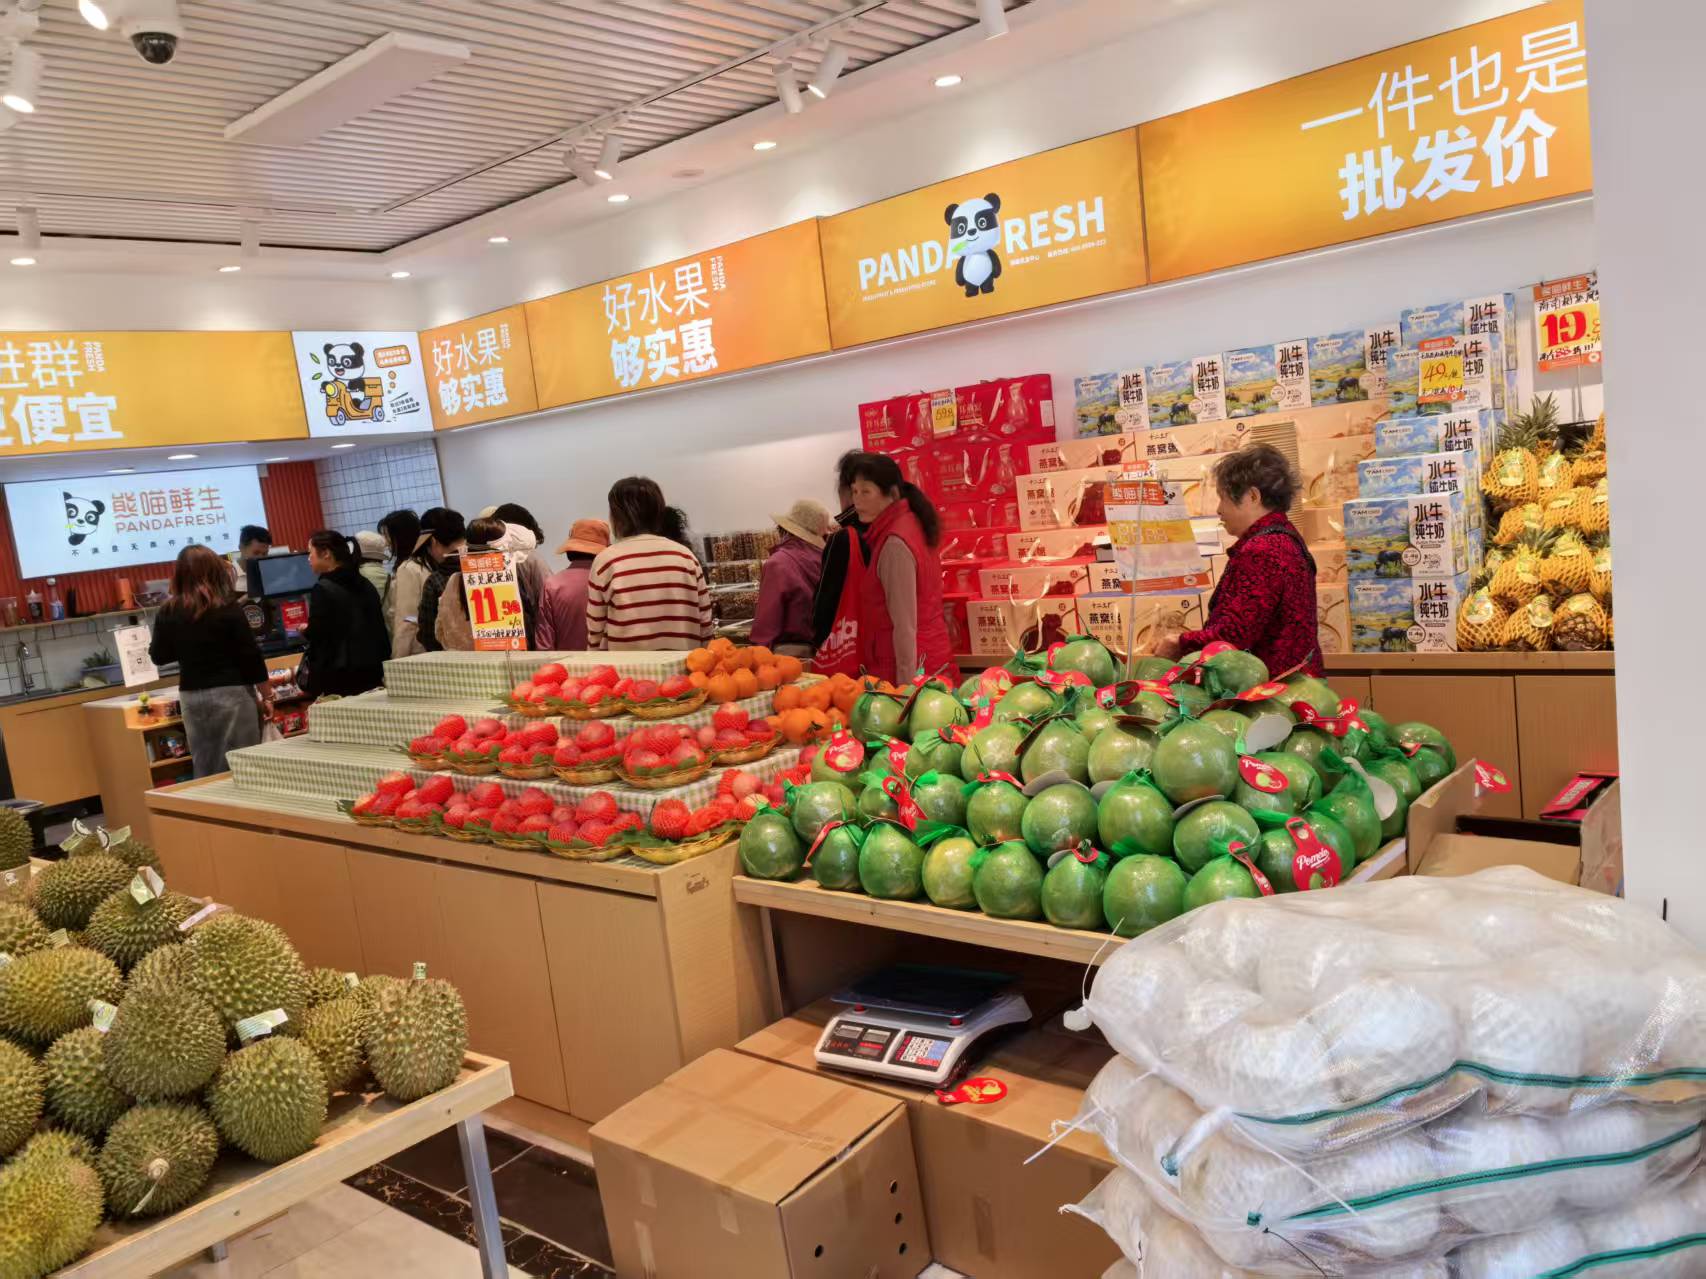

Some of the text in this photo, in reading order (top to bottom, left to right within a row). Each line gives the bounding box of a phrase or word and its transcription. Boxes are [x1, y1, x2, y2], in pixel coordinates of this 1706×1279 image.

[1301, 20, 1587, 138] 一件也是
[1338, 108, 1557, 220] 批发价
[1004, 196, 1105, 253] RESH
[603, 262, 710, 334] 好水果
[1470, 301, 1497, 322] 水牛
[1369, 330, 1395, 348] 水牛
[432, 328, 502, 377] 好水果
[610, 318, 718, 388] 够实惠
[1280, 345, 1303, 362] 水牛
[1370, 349, 1387, 366] 纯牛
[1196, 360, 1218, 377] 水牛
[1280, 361, 1304, 378] 纯牛奶
[1464, 359, 1484, 376] 牛奶
[1122, 373, 1142, 389] 水牛
[1197, 376, 1220, 392] 纯牛奶
[439, 368, 509, 417] 够实惠
[1122, 388, 1143, 403] 纯牛奶
[0, 391, 125, 446] 便宜
[1444, 419, 1472, 438] 水牛
[1428, 460, 1456, 479] 水牛
[112, 487, 224, 518] 熊喵鲜生
[1414, 502, 1443, 521] 水牛
[115, 513, 227, 534] PANDAFRESH
[1415, 523, 1445, 540] 纯牛奶
[1101, 578, 1121, 590] 燕窝
[1418, 582, 1448, 601] 水牛
[1419, 601, 1449, 619] 纯牛奶
[1296, 847, 1330, 870] Pomelo
